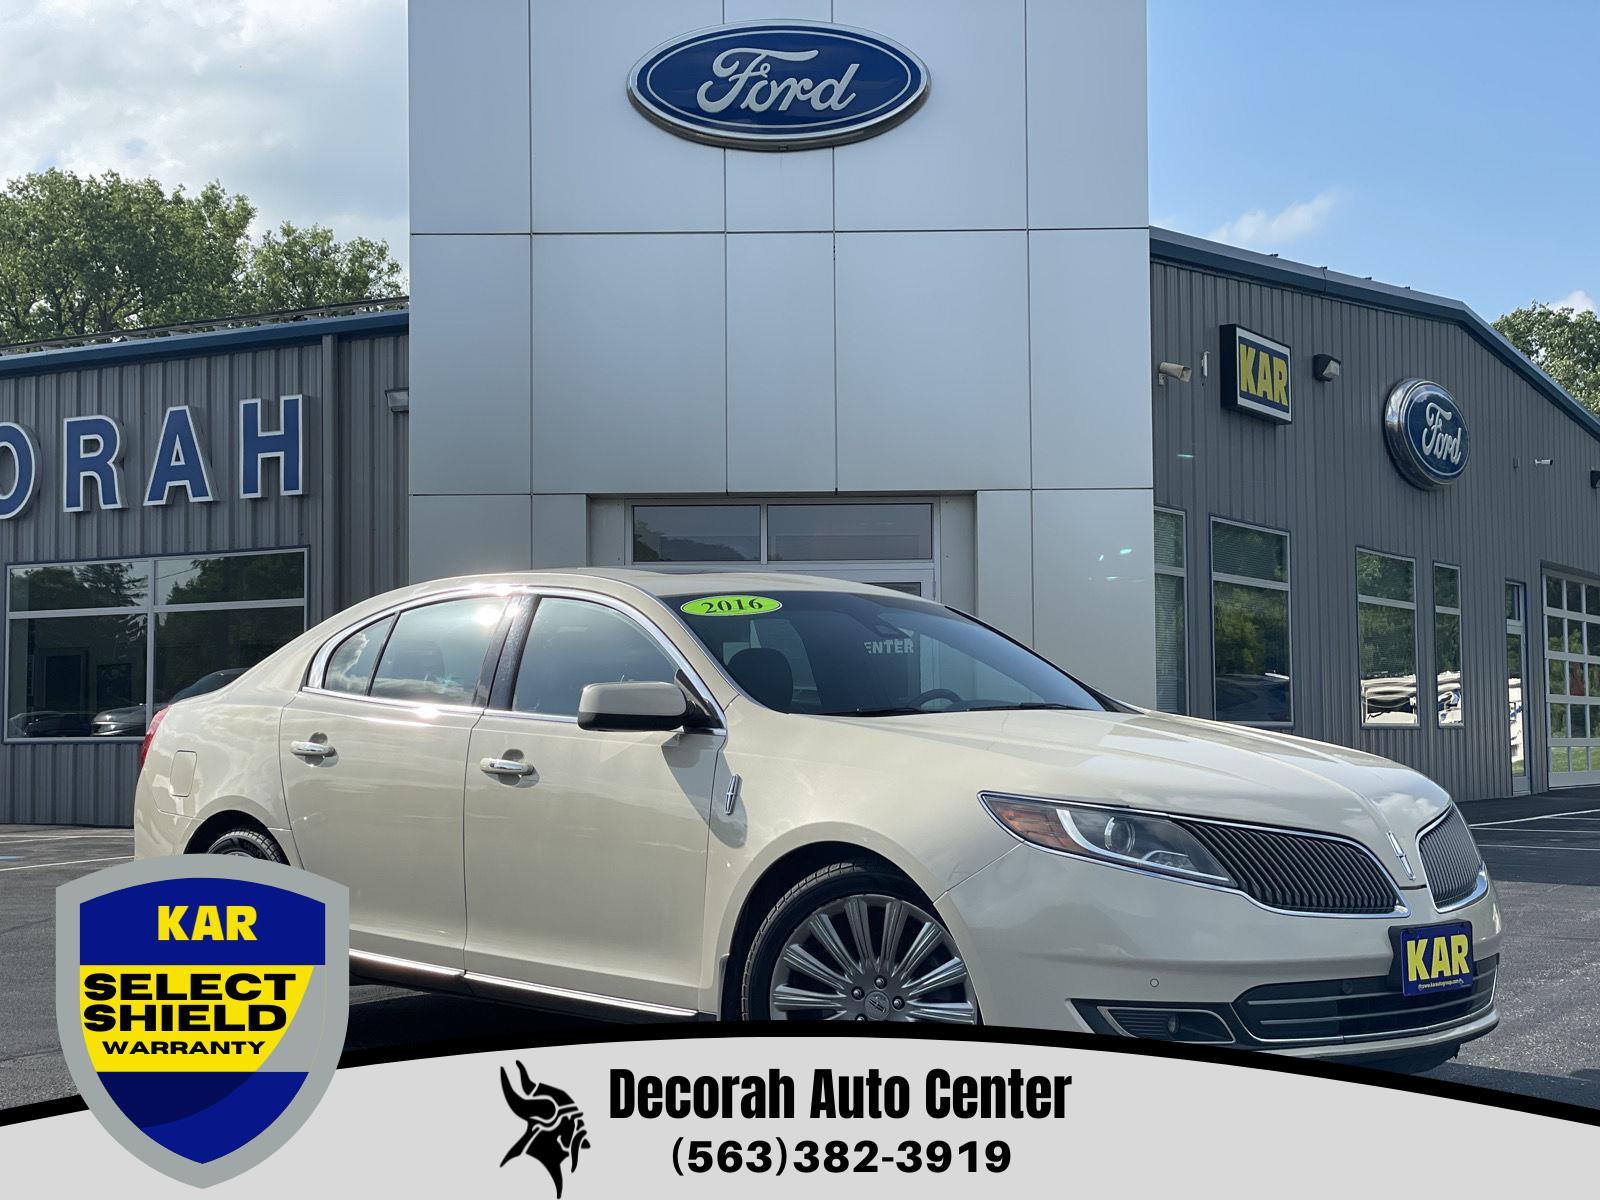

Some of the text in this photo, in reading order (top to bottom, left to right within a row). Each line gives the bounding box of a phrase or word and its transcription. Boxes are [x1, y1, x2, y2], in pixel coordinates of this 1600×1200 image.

[697, 48, 860, 113] Ford
[1240, 343, 1289, 407] KAR
[1421, 402, 1462, 465] Ford
[701, 598, 763, 614] 2016
[1407, 934, 1470, 982] KAR
